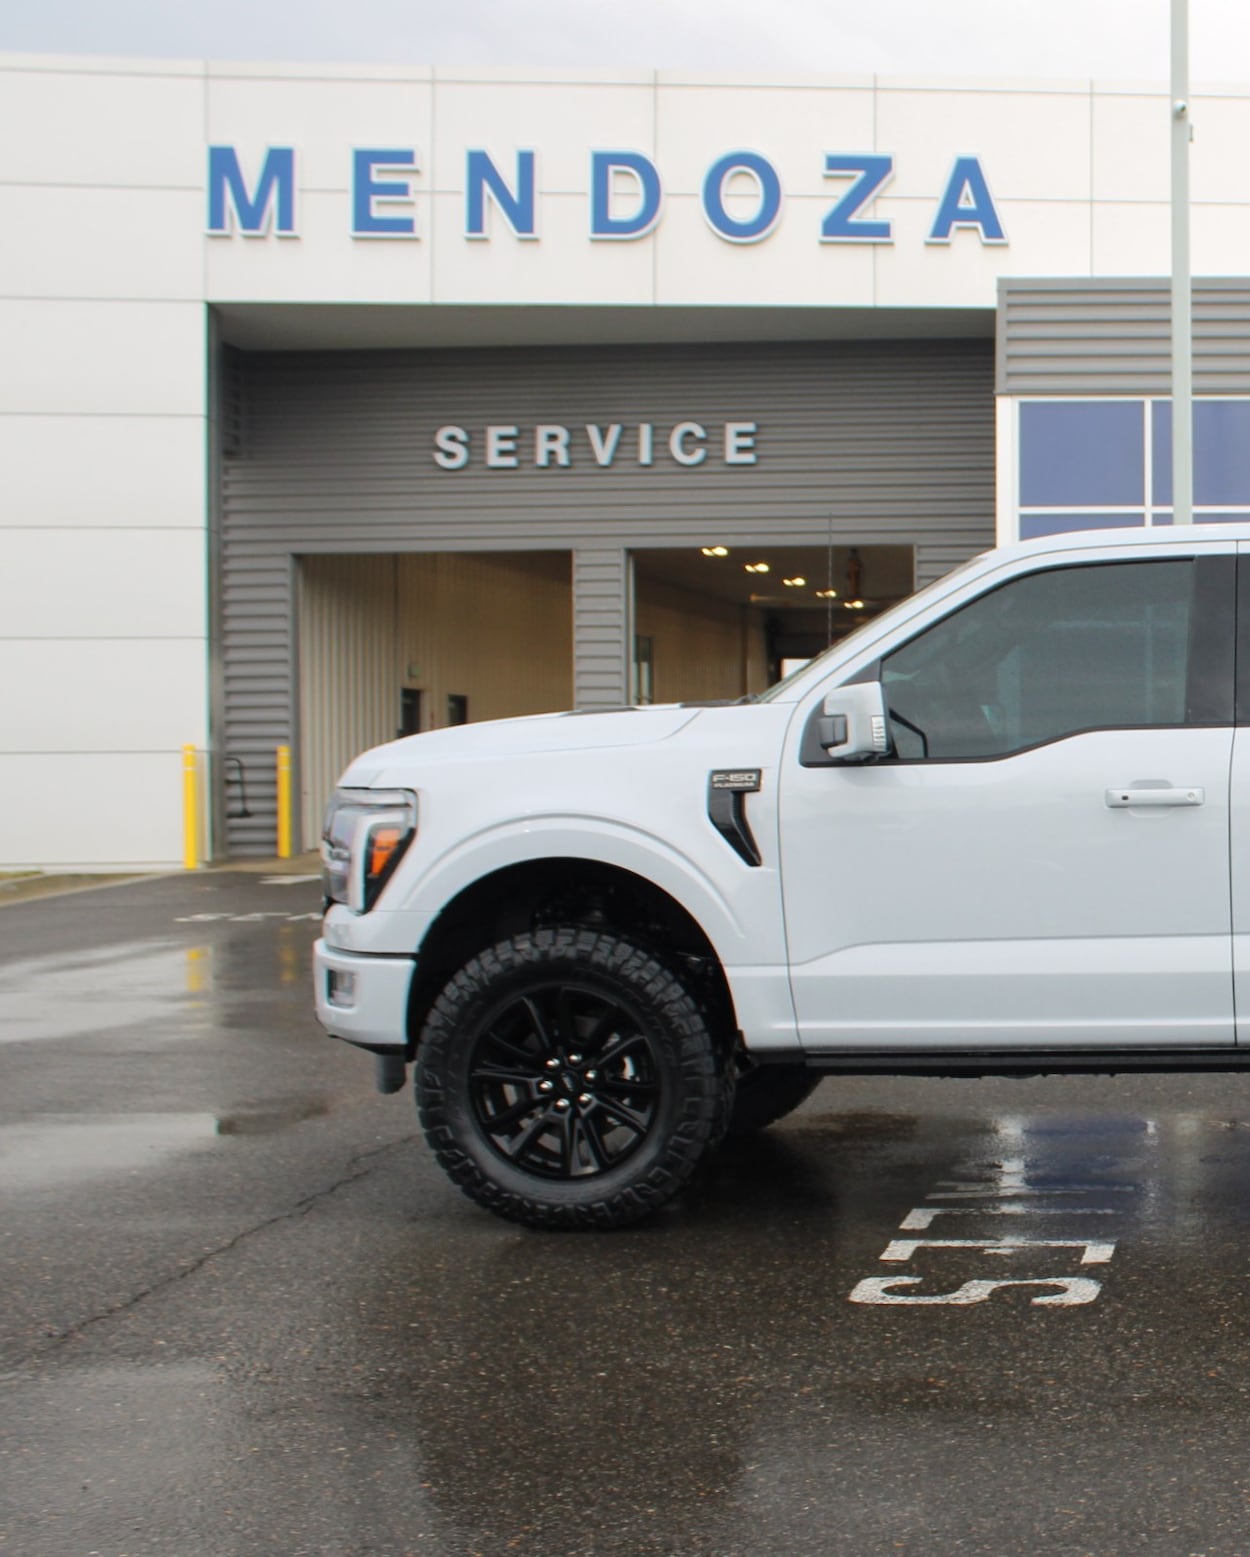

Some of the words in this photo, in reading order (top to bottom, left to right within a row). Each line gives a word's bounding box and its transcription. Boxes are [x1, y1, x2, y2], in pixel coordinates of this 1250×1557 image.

[205, 144, 1008, 246] MENDOZA
[433, 421, 758, 469] SERVICE
[712, 773, 757, 782] F-150
